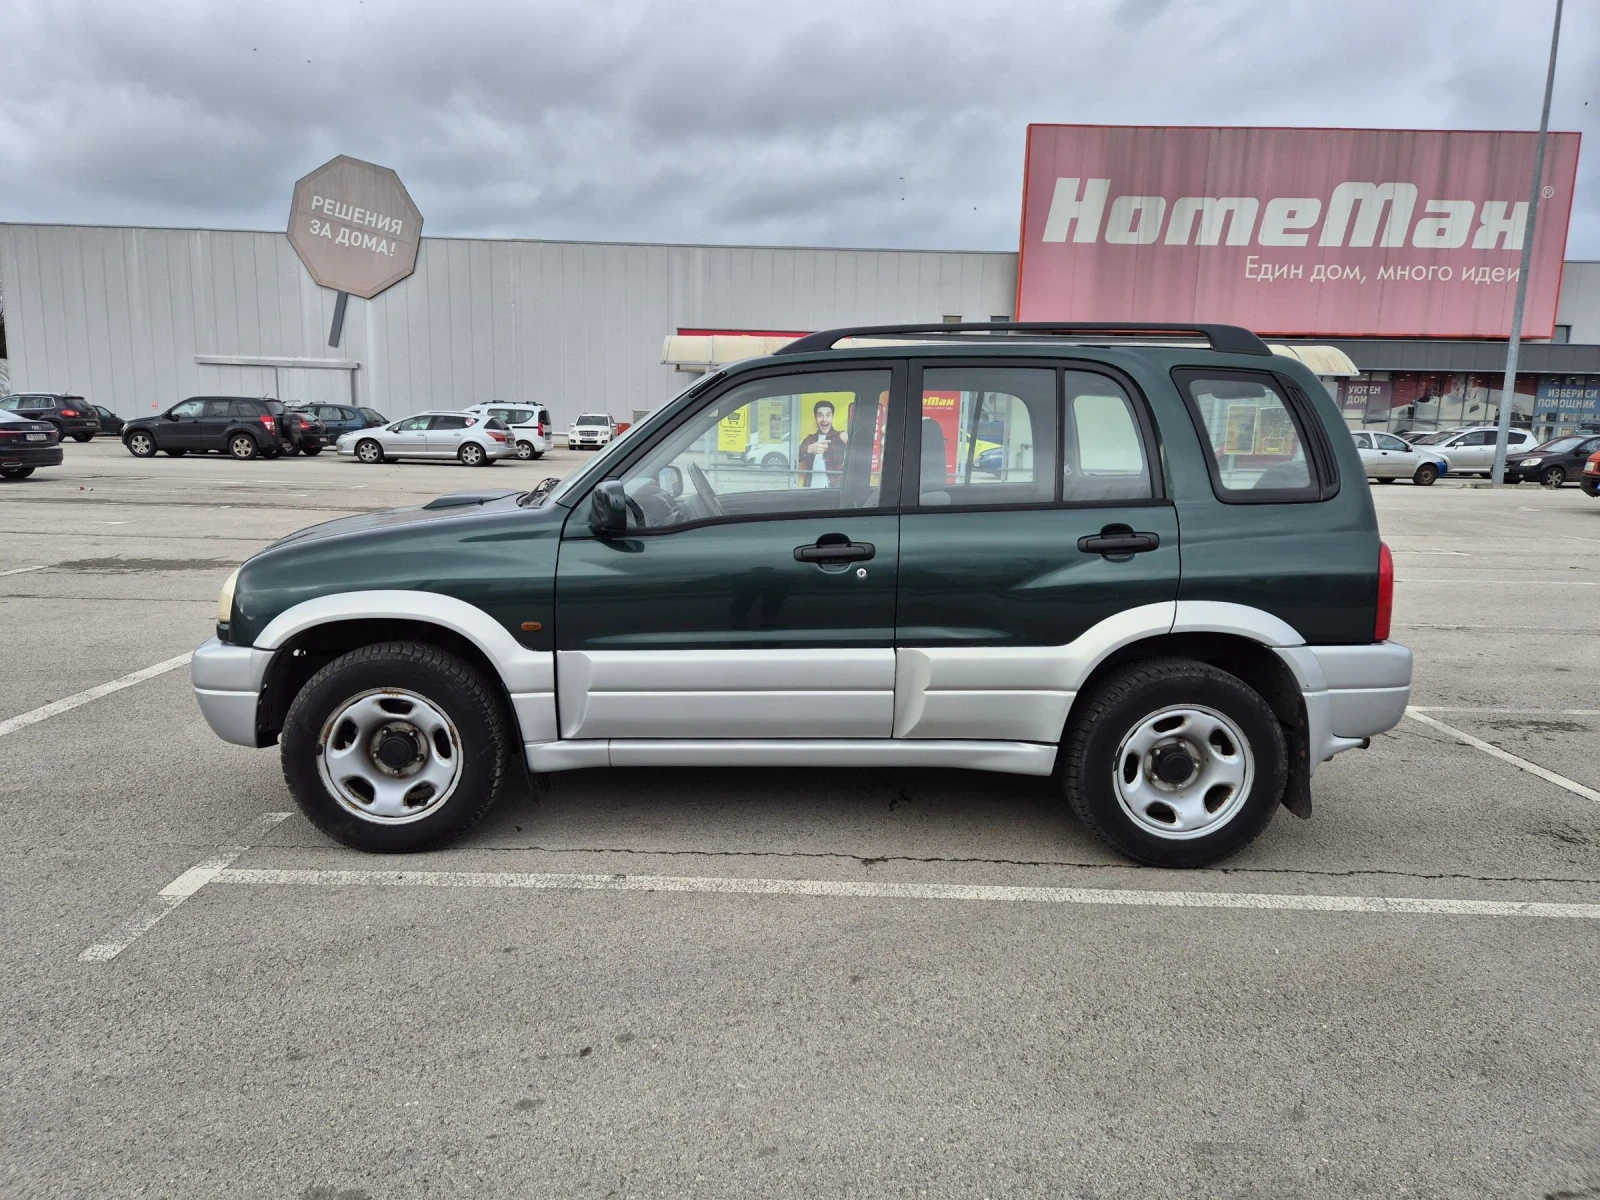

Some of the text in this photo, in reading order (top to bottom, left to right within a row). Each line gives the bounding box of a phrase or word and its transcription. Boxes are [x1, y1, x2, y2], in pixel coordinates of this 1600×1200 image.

[311, 195, 403, 235] РЕШЕНИЯ
[1042, 177, 1538, 250] HomeMax
[309, 219, 397, 257] ЗА ДОМА!
[1244, 256, 1521, 284] Един дом, много идеи
[1347, 395, 1367, 405] ДОМ
[1348, 385, 1381, 394] УЮТЕН
[1538, 399, 1596, 409] ПОМОЩНИК
